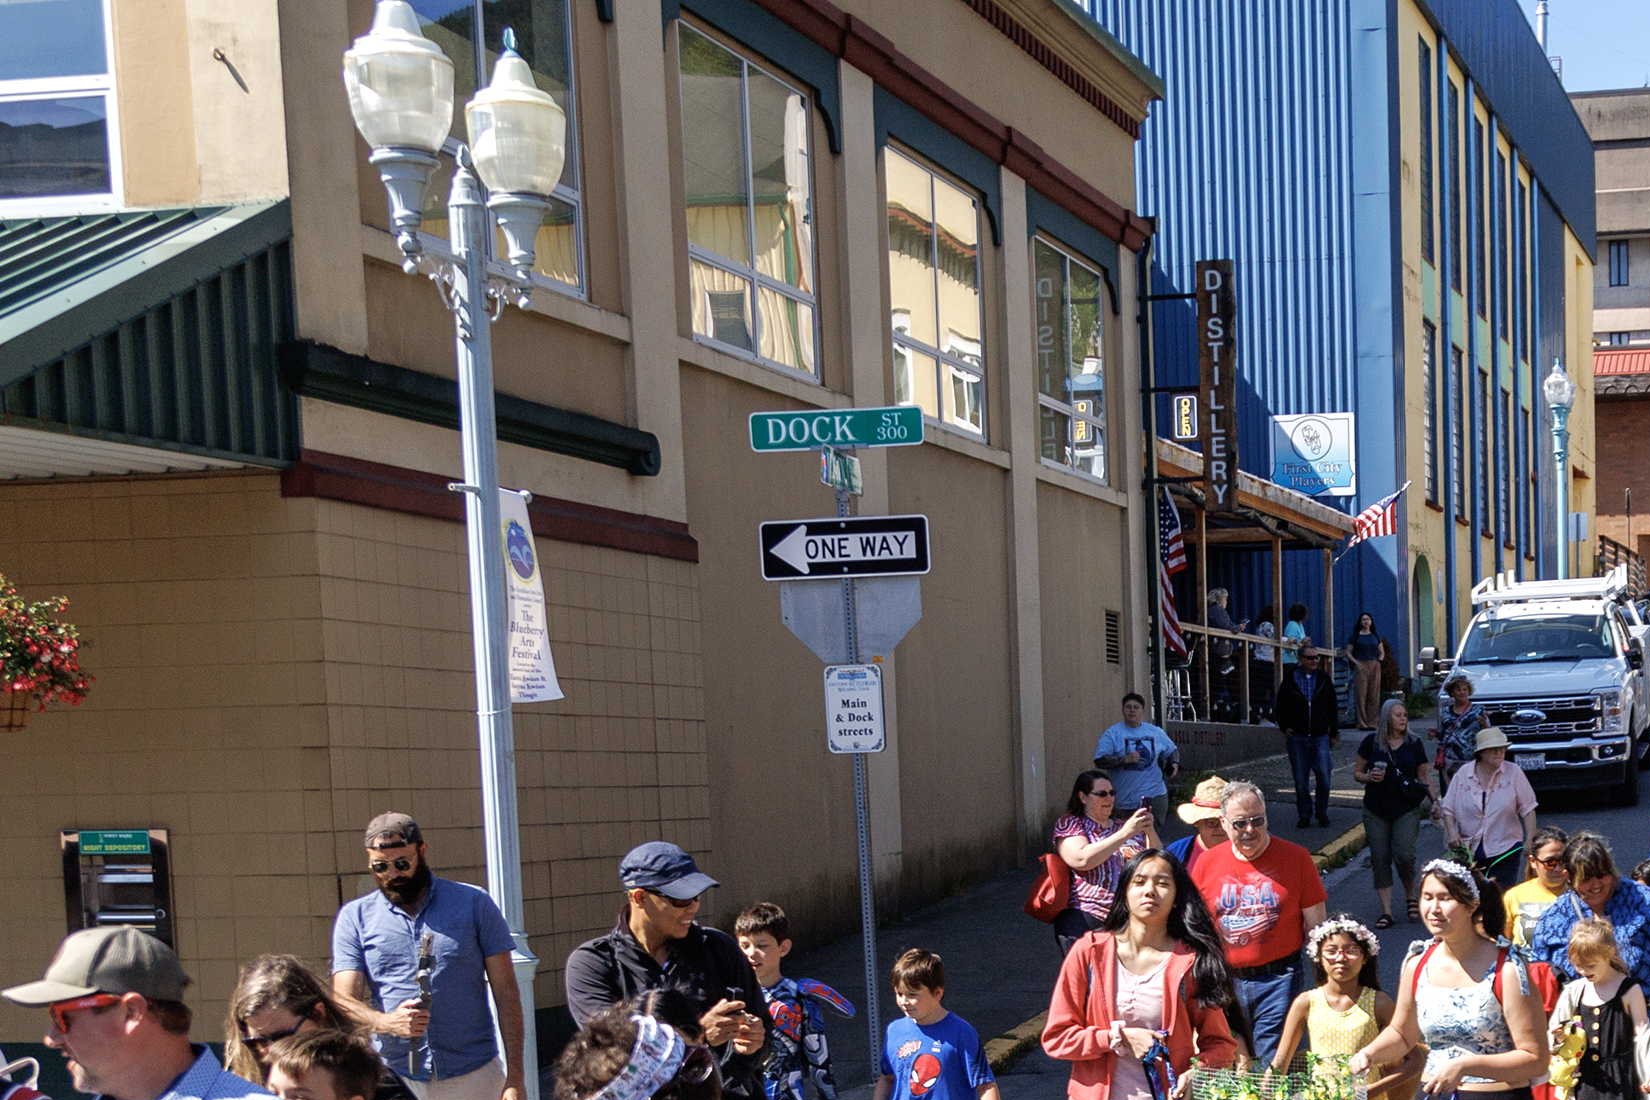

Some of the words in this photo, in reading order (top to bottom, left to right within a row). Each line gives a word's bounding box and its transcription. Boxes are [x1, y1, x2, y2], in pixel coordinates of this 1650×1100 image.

[1204, 269, 1229, 504] DISTILLERY
[1181, 398, 1191, 436] OPEN
[766, 415, 859, 445] DOCK
[881, 412, 901, 427] ST
[876, 426, 908, 441] 300
[1282, 463, 1313, 475] First
[1315, 461, 1342, 475] City
[1290, 475, 1335, 489] Players
[805, 537, 851, 560] ONE
[859, 534, 909, 557] WAY
[841, 699, 868, 709] Main
[835, 713, 845, 723] &
[848, 711, 875, 722] Dock
[838, 727, 874, 737] streets
[1220, 881, 1278, 910] USA
